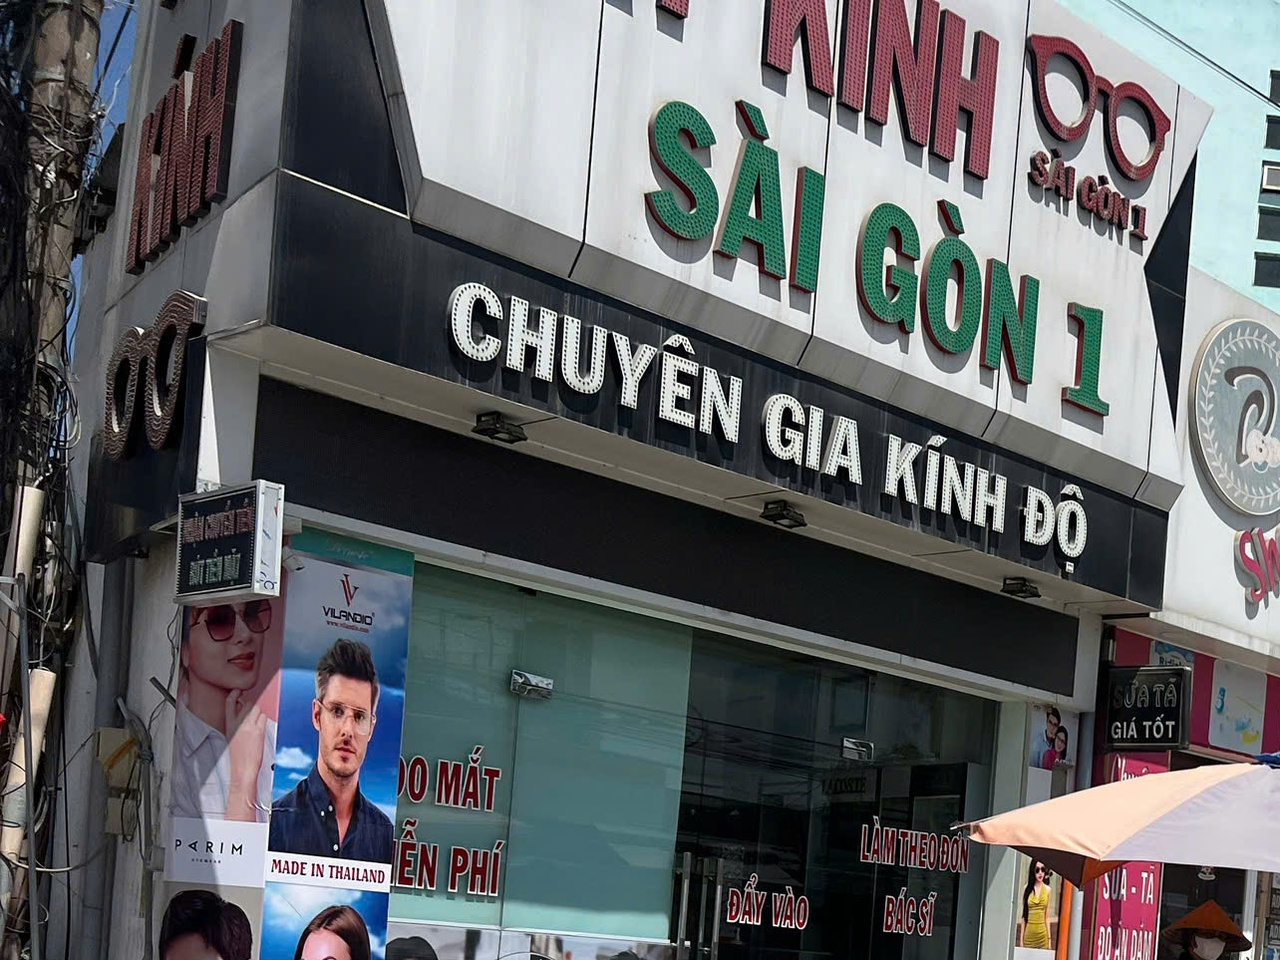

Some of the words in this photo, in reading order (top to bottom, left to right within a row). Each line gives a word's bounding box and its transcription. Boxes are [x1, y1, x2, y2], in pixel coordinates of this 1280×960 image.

[1027, 148, 1076, 201] SÀI
[1077, 175, 1130, 230] GÒN
[1130, 204, 1149, 241] 1
[644, 100, 825, 294] SÀI
[856, 200, 1040, 385] GÒN
[1062, 302, 1109, 417] 1
[448, 281, 743, 444] CHUYÊN
[762, 393, 864, 486] GIA
[885, 434, 1007, 534] KÍNH
[1022, 483, 1089, 573] ĐỘ
[322, 606, 373, 626] VILANDIO
[1111, 716, 1137, 739] GIÁ
[1142, 714, 1176, 739] TỐT
[435, 745, 502, 812] MẮT
[174, 838, 244, 856] PARIM
[270, 858, 308, 877] MADE
[311, 863, 325, 879] IN
[327, 865, 386, 885] THAILAND
[447, 840, 506, 897] PHÍ
[860, 815, 897, 866] LÀM
[898, 829, 938, 871] THEO
[938, 831, 970, 873] ĐƠN
[726, 873, 767, 926] ĐẨY
[771, 886, 810, 930] VÀO
[882, 887, 916, 936] BÁC
[917, 891, 938, 937] SĨ
[1141, 866, 1155, 904] TÃ
